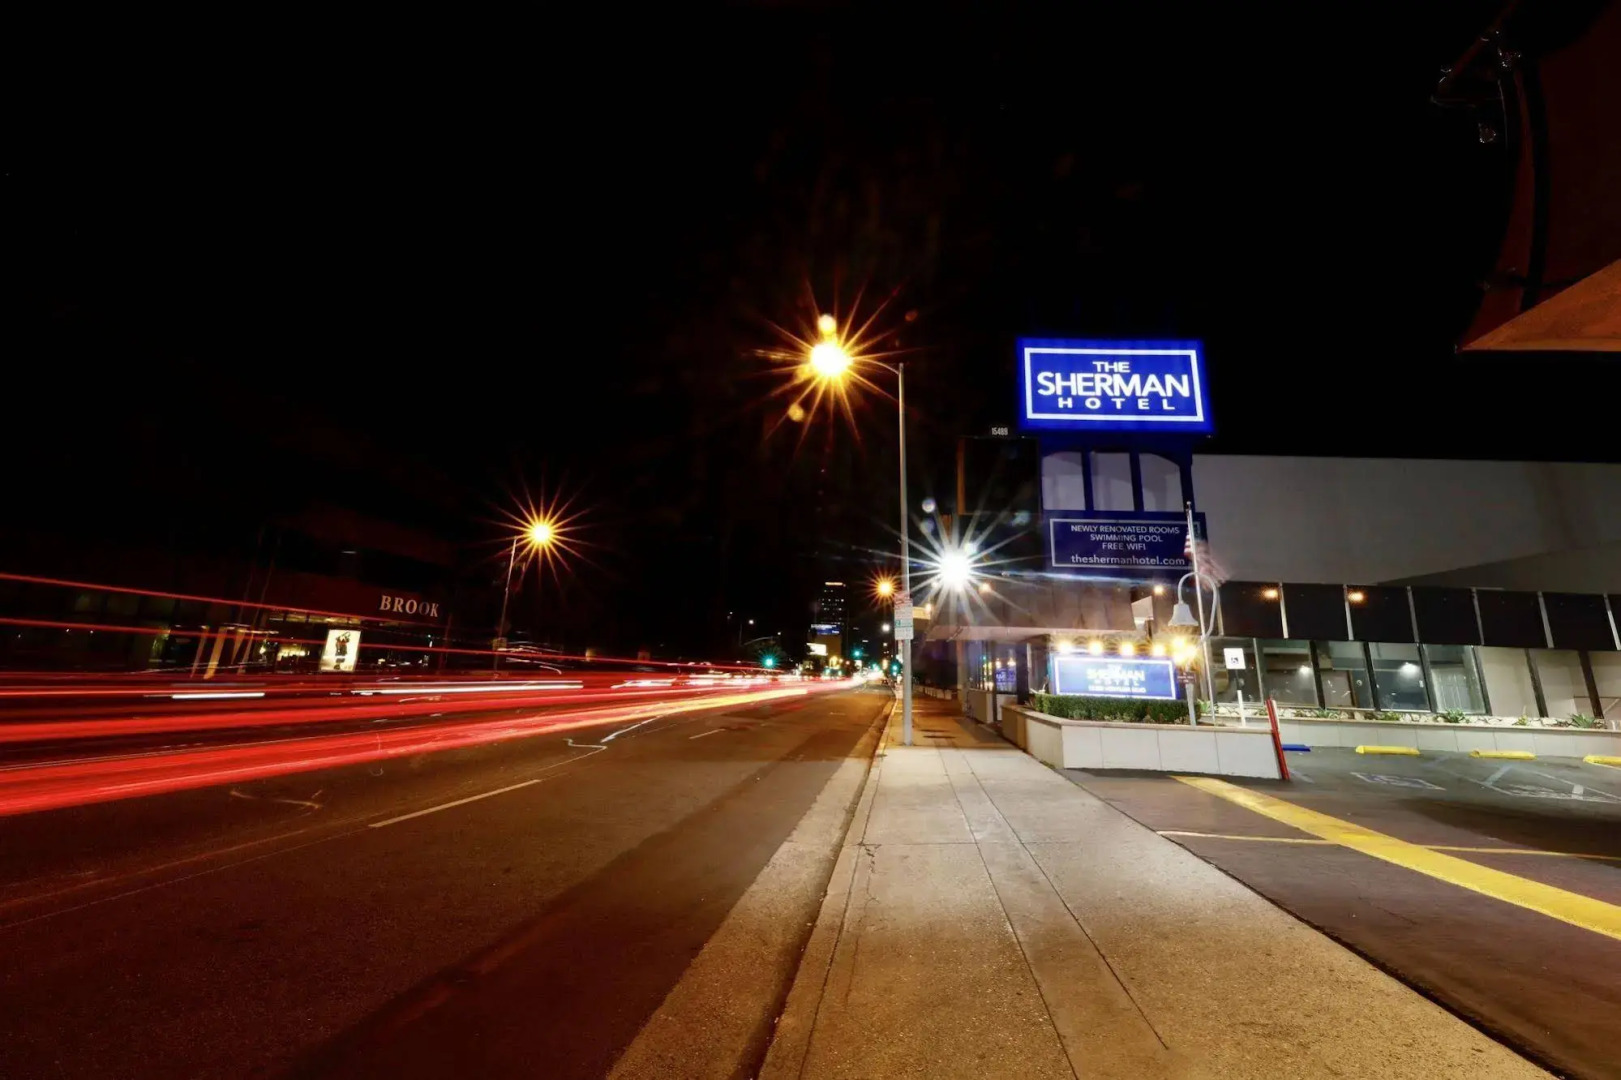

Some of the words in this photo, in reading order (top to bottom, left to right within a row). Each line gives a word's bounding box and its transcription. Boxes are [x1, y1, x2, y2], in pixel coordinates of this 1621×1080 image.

[1092, 361, 1131, 373] THE
[1037, 371, 1190, 397] SHERMAN
[1057, 397, 1175, 410] HOTEL
[1070, 524, 1098, 533] NEWLY
[1099, 525, 1148, 534] RENOVATED
[1148, 526, 1180, 535] ROOMS
[1090, 533, 1136, 542] SWIMMING
[1138, 534, 1163, 543] POOL
[1102, 542, 1124, 550] FREE
[1125, 543, 1146, 551] WIFI
[1070, 554, 1185, 566] theshermanhotel.com
[379, 595, 439, 617] BROOK
